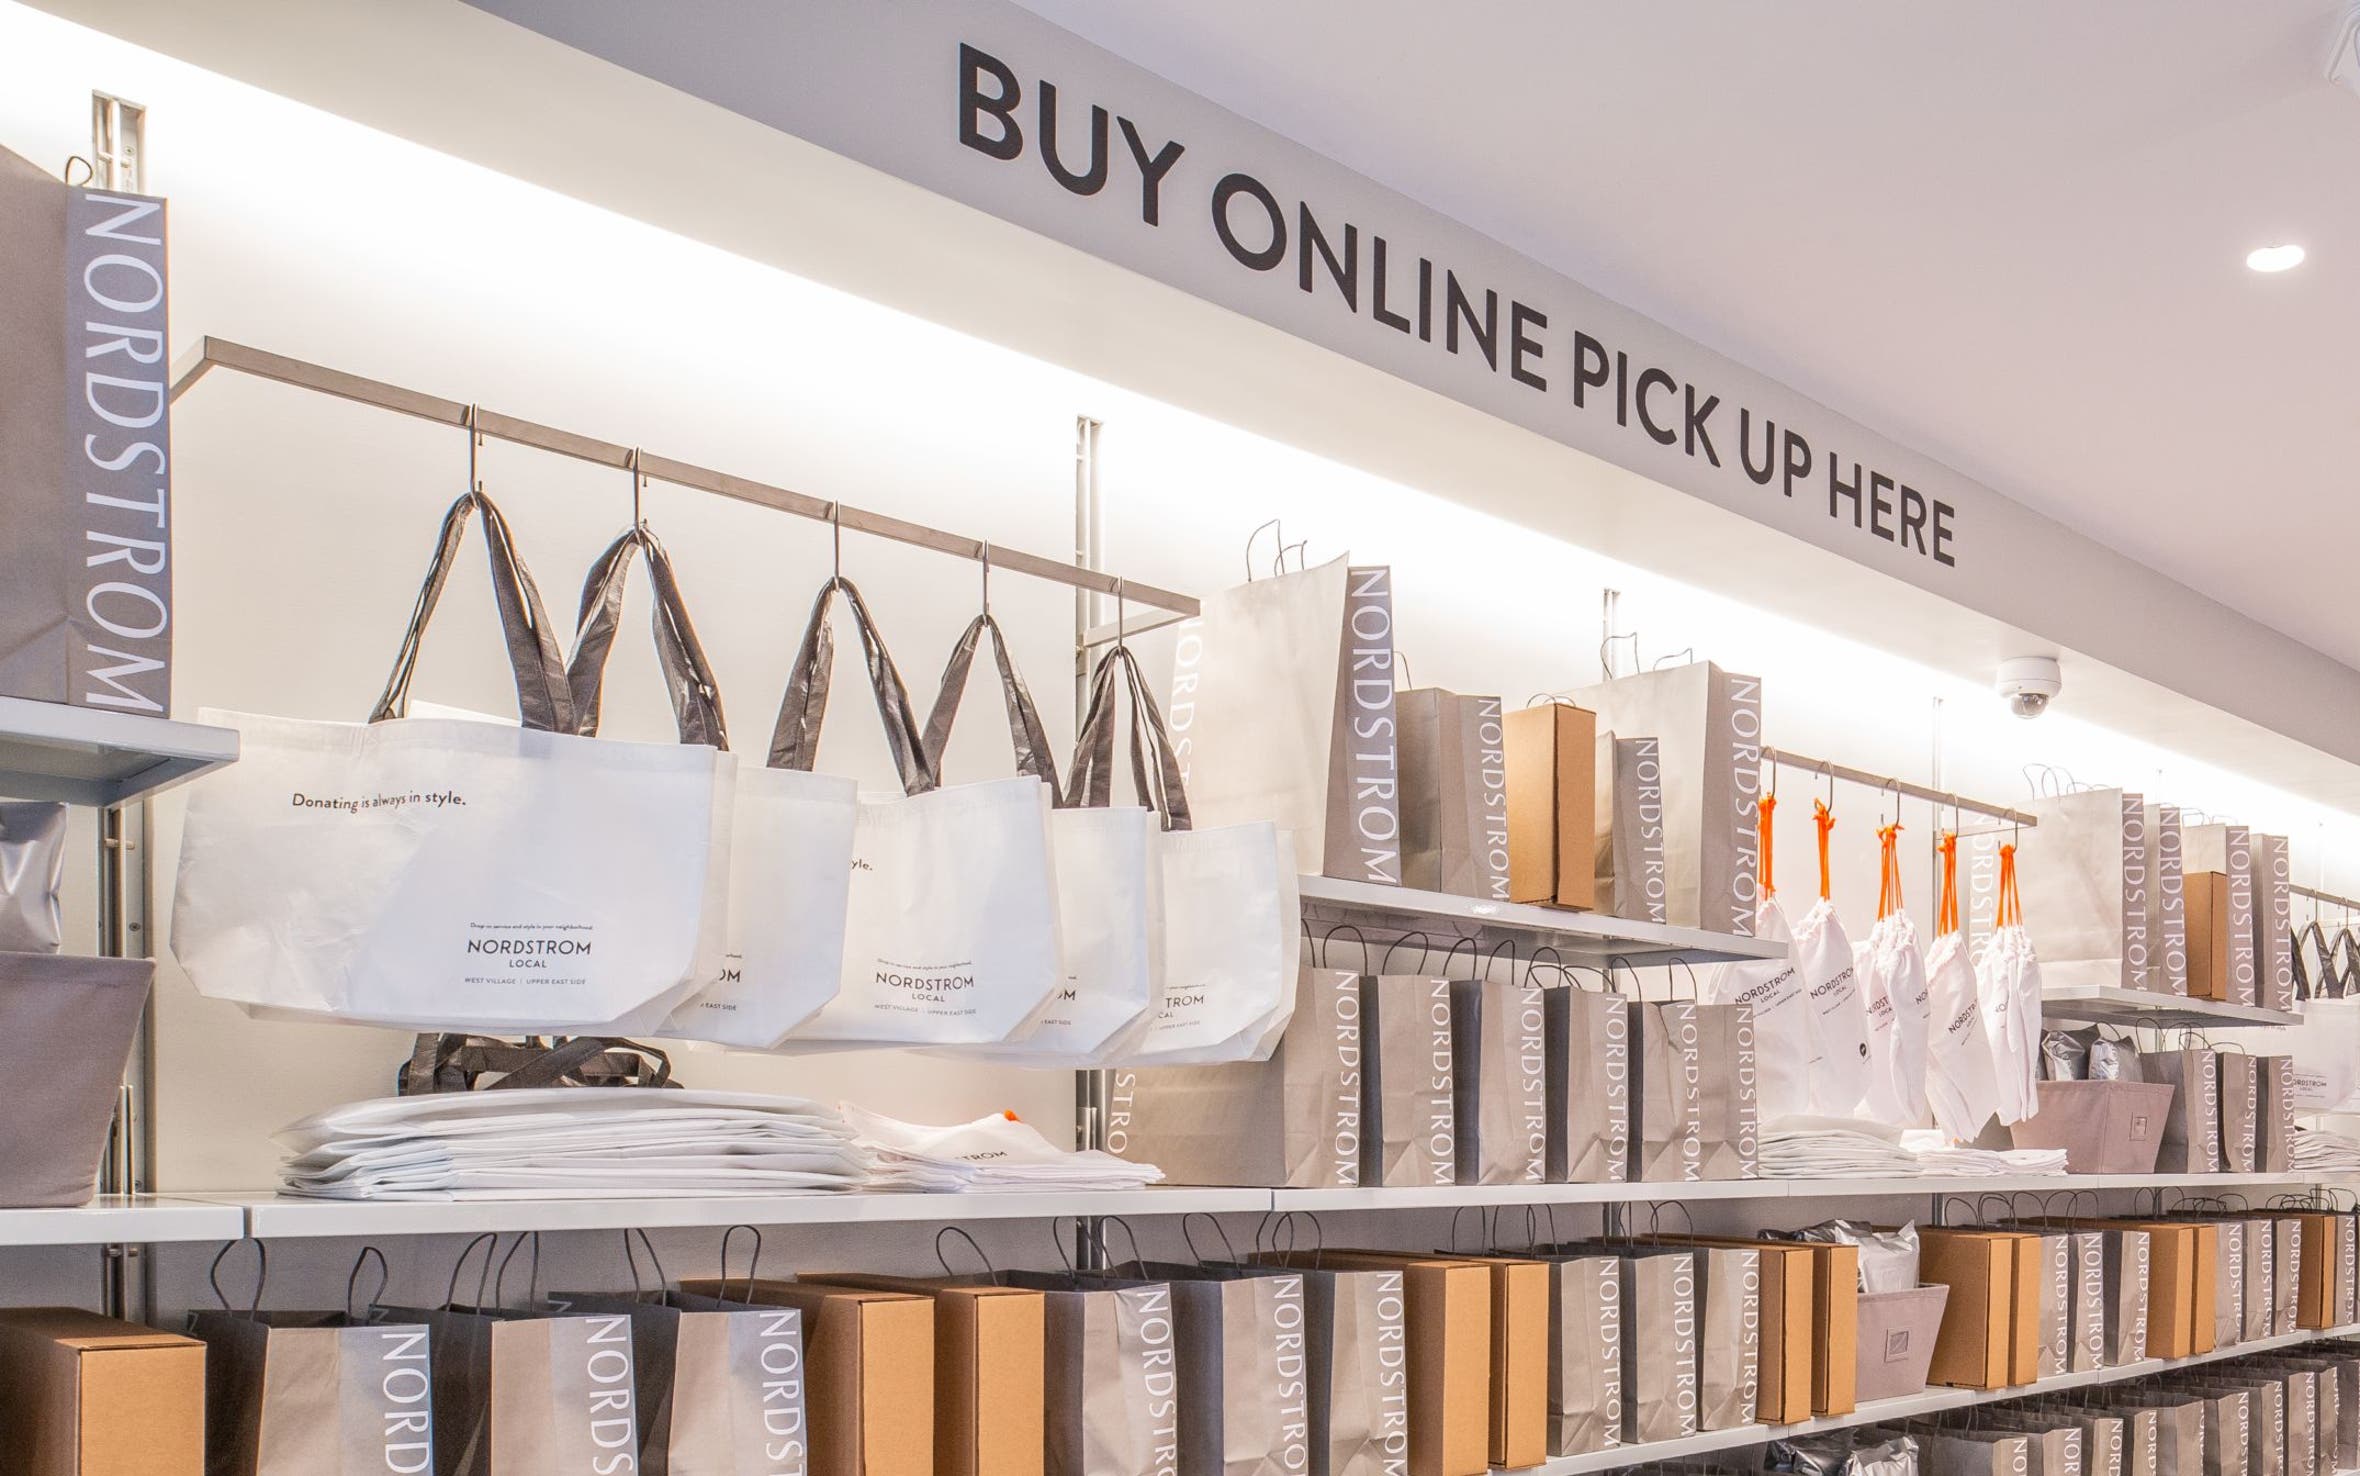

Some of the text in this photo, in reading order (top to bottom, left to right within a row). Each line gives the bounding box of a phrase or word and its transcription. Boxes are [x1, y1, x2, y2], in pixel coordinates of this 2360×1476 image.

[960, 42, 1956, 568] BUY ONLINE PICK UP HERE
[83, 193, 167, 713] NORDSTROM
[292, 790, 467, 814] Donating is always in style.
[1351, 568, 1398, 884] NORDSTROM
[1477, 699, 1510, 901] NORDSTROM
[1730, 678, 1760, 937] NORDSTROM
[851, 858, 873, 871] yle.
[1635, 739, 1665, 924] NORDSTROM
[2122, 797, 2149, 992] NORDSTROM
[2159, 808, 2187, 997] NORDSTROM
[2229, 829, 2256, 1007] NORDSTROM
[467, 939, 592, 955] NORDSTROM
[509, 959, 547, 968] LOCAL
[876, 972, 974, 991] NORDSTROM
[912, 993, 945, 1002] LOCAL
[2272, 837, 2293, 1011] NORDSTROM
[1107, 1072, 1136, 1154] STRO
[1335, 971, 1360, 1185] NORDSTROM
[1430, 979, 1454, 1185] NORDSTROM
[1520, 987, 1546, 1182] NORDSTROM
[1605, 997, 1628, 1182] NORDSTROM
[1679, 1003, 1701, 1182] NORDSTROM
[1737, 1008, 1759, 1180] NORDSTROM
[2201, 1050, 2220, 1173] NORDSTROM
[2241, 1056, 2257, 1172] NORDSTROM
[2280, 1059, 2296, 1174] NORDSTROM
[1599, 1257, 1621, 1447] NORDSTROM
[1672, 1255, 1697, 1437] NORDSTROM
[1741, 1250, 1759, 1424] NORDSTROM
[2055, 1236, 2068, 1375] NORDSTROM
[2084, 1234, 2104, 1370] NORDSTROM
[2134, 1232, 2150, 1362] NORDSTROM
[2287, 1220, 2301, 1333] NORDSTROM
[381, 1333, 430, 1475] NORD
[585, 1317, 634, 1476] NORDS
[759, 1312, 803, 1476] NORDST
[1273, 1277, 1306, 1476] NORDSTRO
